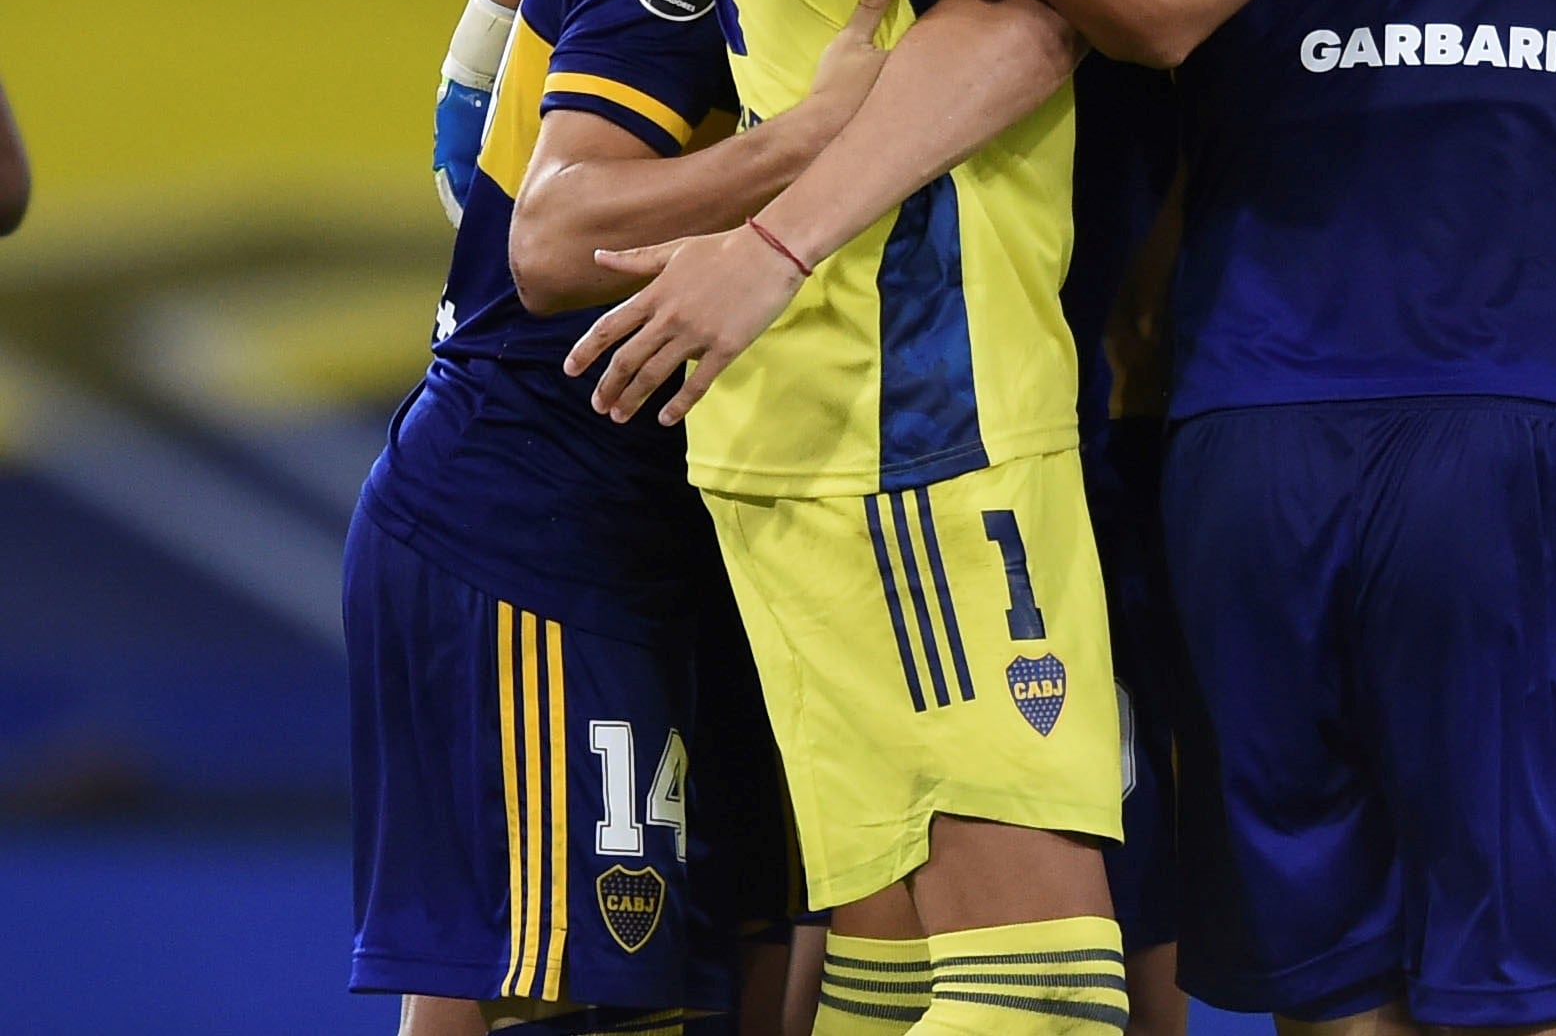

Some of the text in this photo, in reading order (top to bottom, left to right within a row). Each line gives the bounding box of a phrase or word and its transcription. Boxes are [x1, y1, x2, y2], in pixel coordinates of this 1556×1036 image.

[979, 510, 1046, 640] 1
[1013, 678, 1064, 701] CABJ
[589, 720, 687, 863] 14
[606, 894, 656, 913] CABJ
